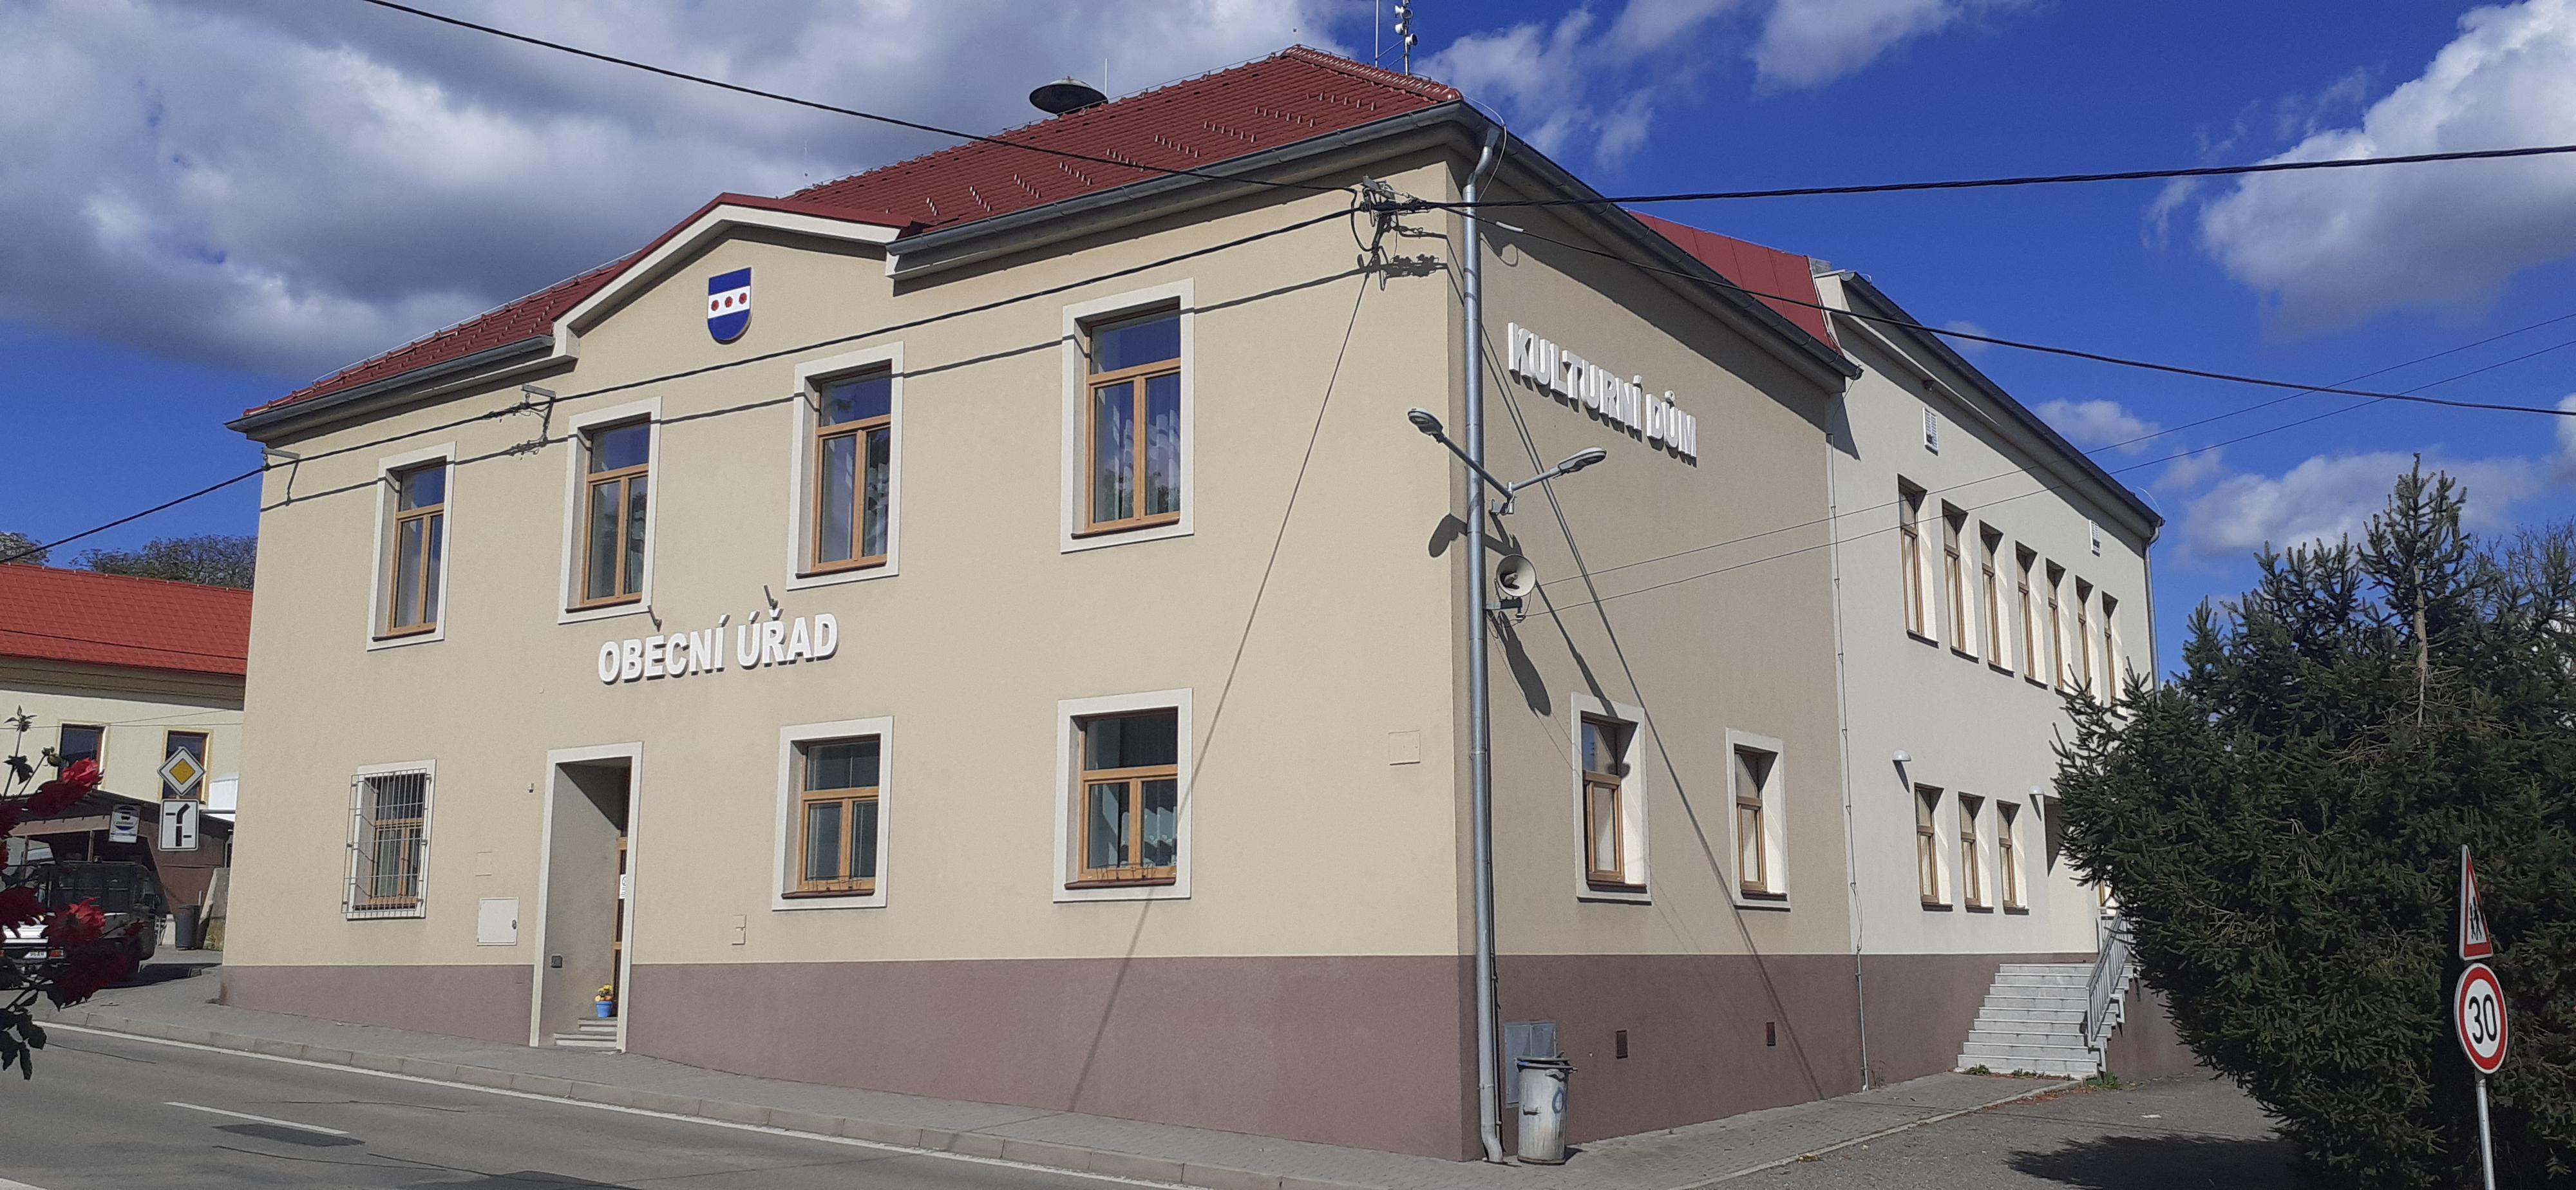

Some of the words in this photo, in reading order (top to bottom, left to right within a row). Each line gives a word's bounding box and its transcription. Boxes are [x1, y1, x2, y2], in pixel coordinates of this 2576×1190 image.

[1508, 322, 1642, 431] KULTURNÍ
[1646, 390, 1697, 458] DŮM
[598, 614, 730, 683] OBECNÍ
[737, 609, 838, 667] ÚŘAD
[2468, 994, 2497, 1044] 30
